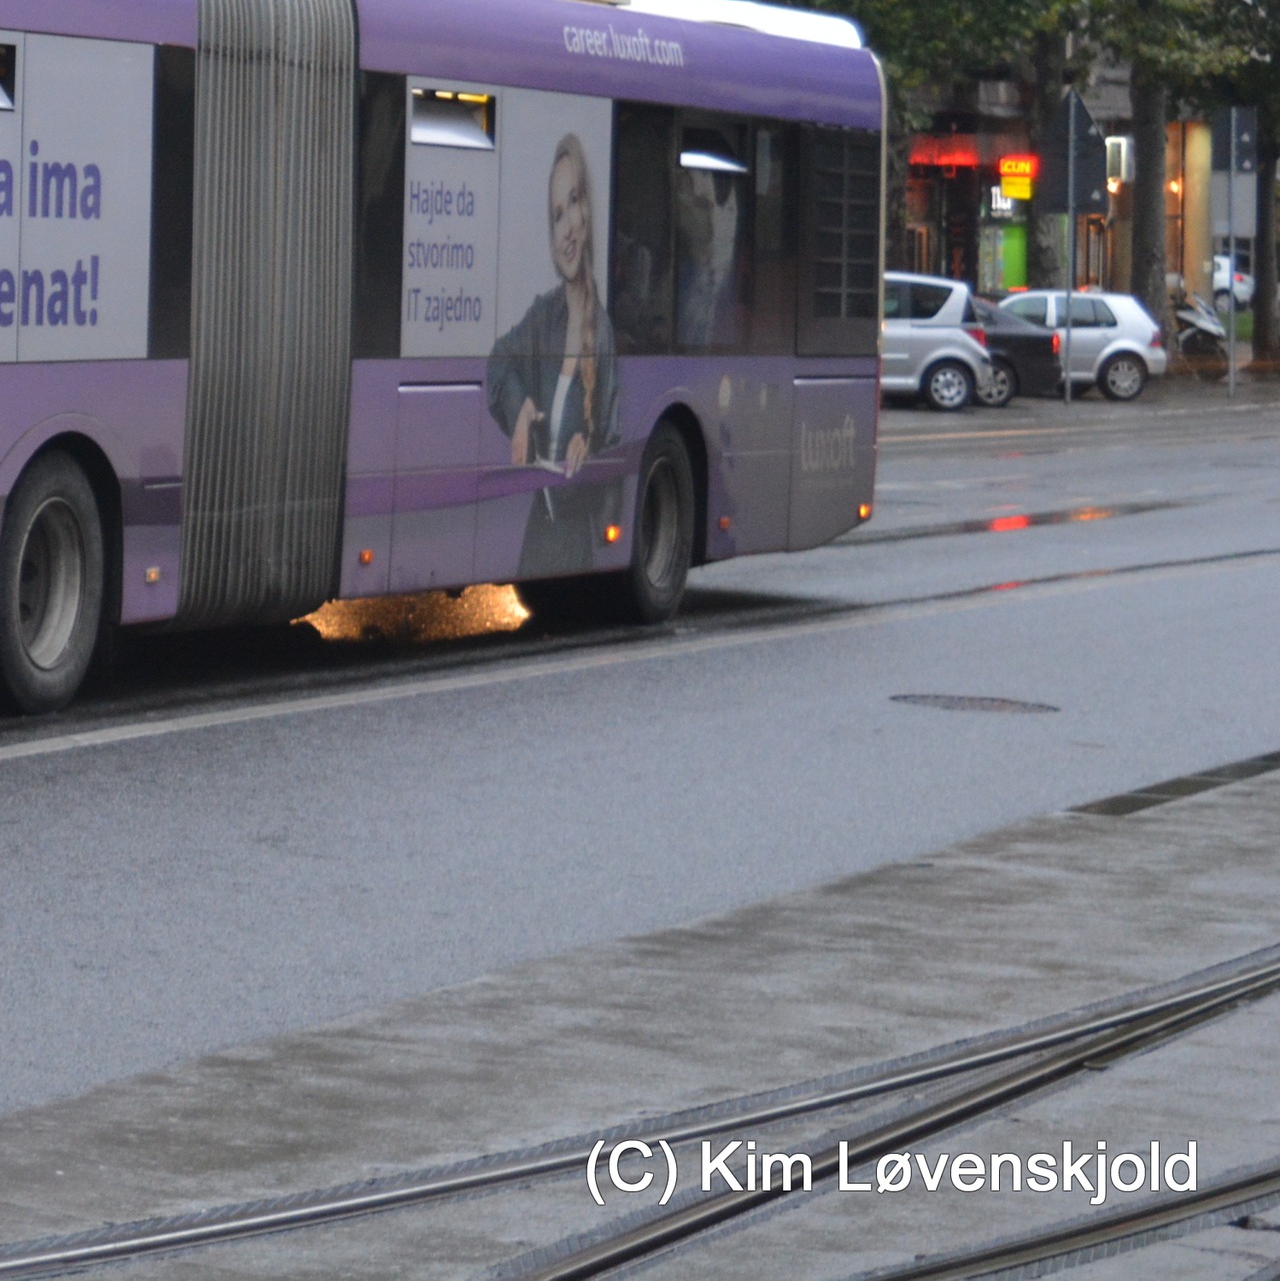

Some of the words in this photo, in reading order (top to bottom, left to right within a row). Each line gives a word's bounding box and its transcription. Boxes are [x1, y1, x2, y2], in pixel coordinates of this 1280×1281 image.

[563, 24, 684, 68] career.luxoft.com
[28, 139, 101, 220] ima
[409, 180, 453, 225] Hajde
[456, 182, 475, 217] da
[408, 235, 474, 269] stvorimo
[407, 287, 421, 322] IT
[424, 287, 481, 332] zajedno
